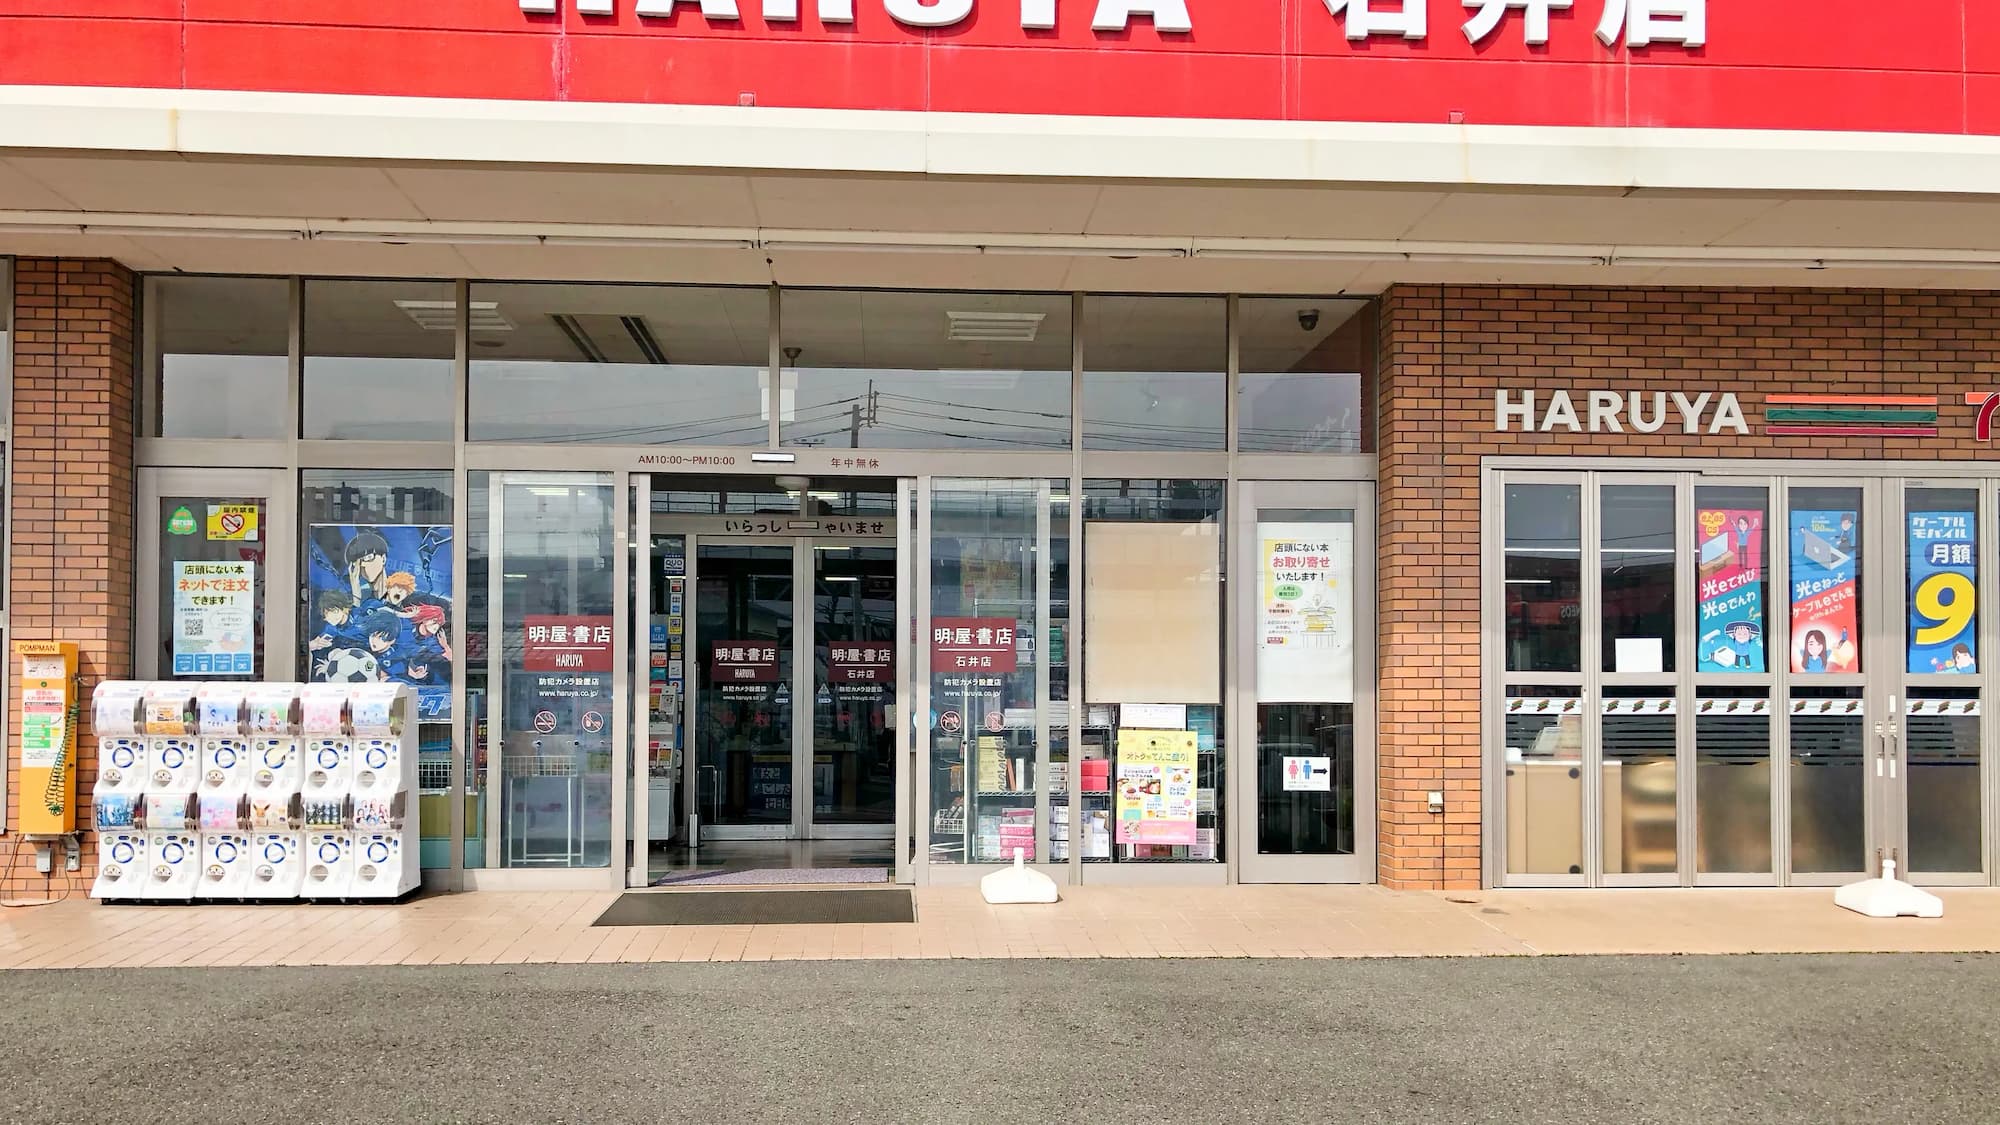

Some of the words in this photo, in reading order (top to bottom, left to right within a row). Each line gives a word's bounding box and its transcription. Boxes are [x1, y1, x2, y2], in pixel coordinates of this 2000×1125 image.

[1495, 389, 1749, 434] HARUYA
[831, 457, 879, 468] 年中無休
[1912, 517, 1967, 528] ケーブル
[1912, 529, 1968, 539] モバイル
[1274, 543, 1329, 553] 店頭にない本
[1931, 544, 1971, 564] 月額
[1272, 556, 1331, 568] お取り寄せ
[184, 565, 244, 575] 店頭にない本
[178, 578, 250, 592] ネットで注文
[19, 644, 56, 652] POMPMAN
[555, 654, 583, 667] HARUYA
[955, 656, 992, 667] 石井店
[847, 669, 875, 679] 石井店
[538, 678, 600, 686] 防犯カメラ設置店
